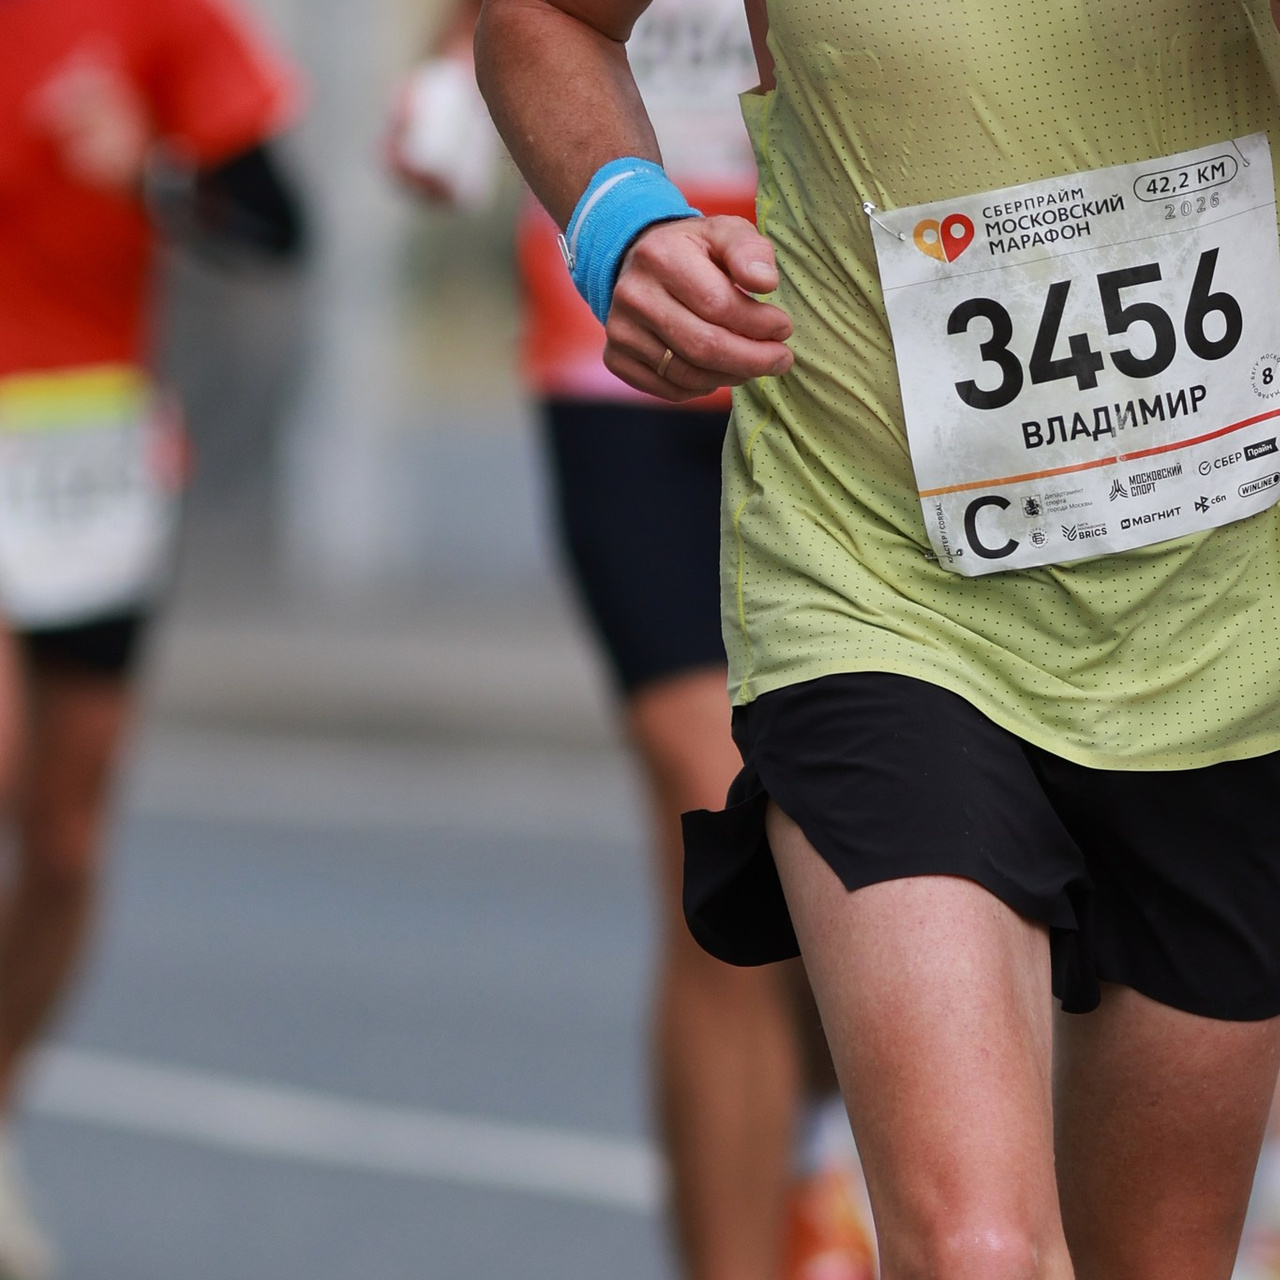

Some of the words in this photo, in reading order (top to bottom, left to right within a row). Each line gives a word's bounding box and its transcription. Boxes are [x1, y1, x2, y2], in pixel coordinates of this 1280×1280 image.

[1146, 172, 1189, 195] 42,2
[982, 188, 1084, 218] СБЕРПРАЙМ
[985, 193, 1125, 238] МОСКОВСКИЙ
[1164, 192, 1220, 220] 2026
[988, 221, 1091, 255] МАРАФОН
[947, 247, 1243, 410] 3456
[1262, 367, 1274, 385] 8
[1021, 384, 1207, 449] ВЛАДИМИР
[1213, 452, 1242, 469] СБЕР
[1247, 443, 1273, 457] Прайм
[1128, 462, 1183, 486] МОСКОВСКИЙ
[1241, 477, 1273, 495] WINLINE
[1130, 482, 1156, 497] СПОРТ
[1211, 495, 1227, 505] сбп
[1078, 527, 1108, 540] BRICS
